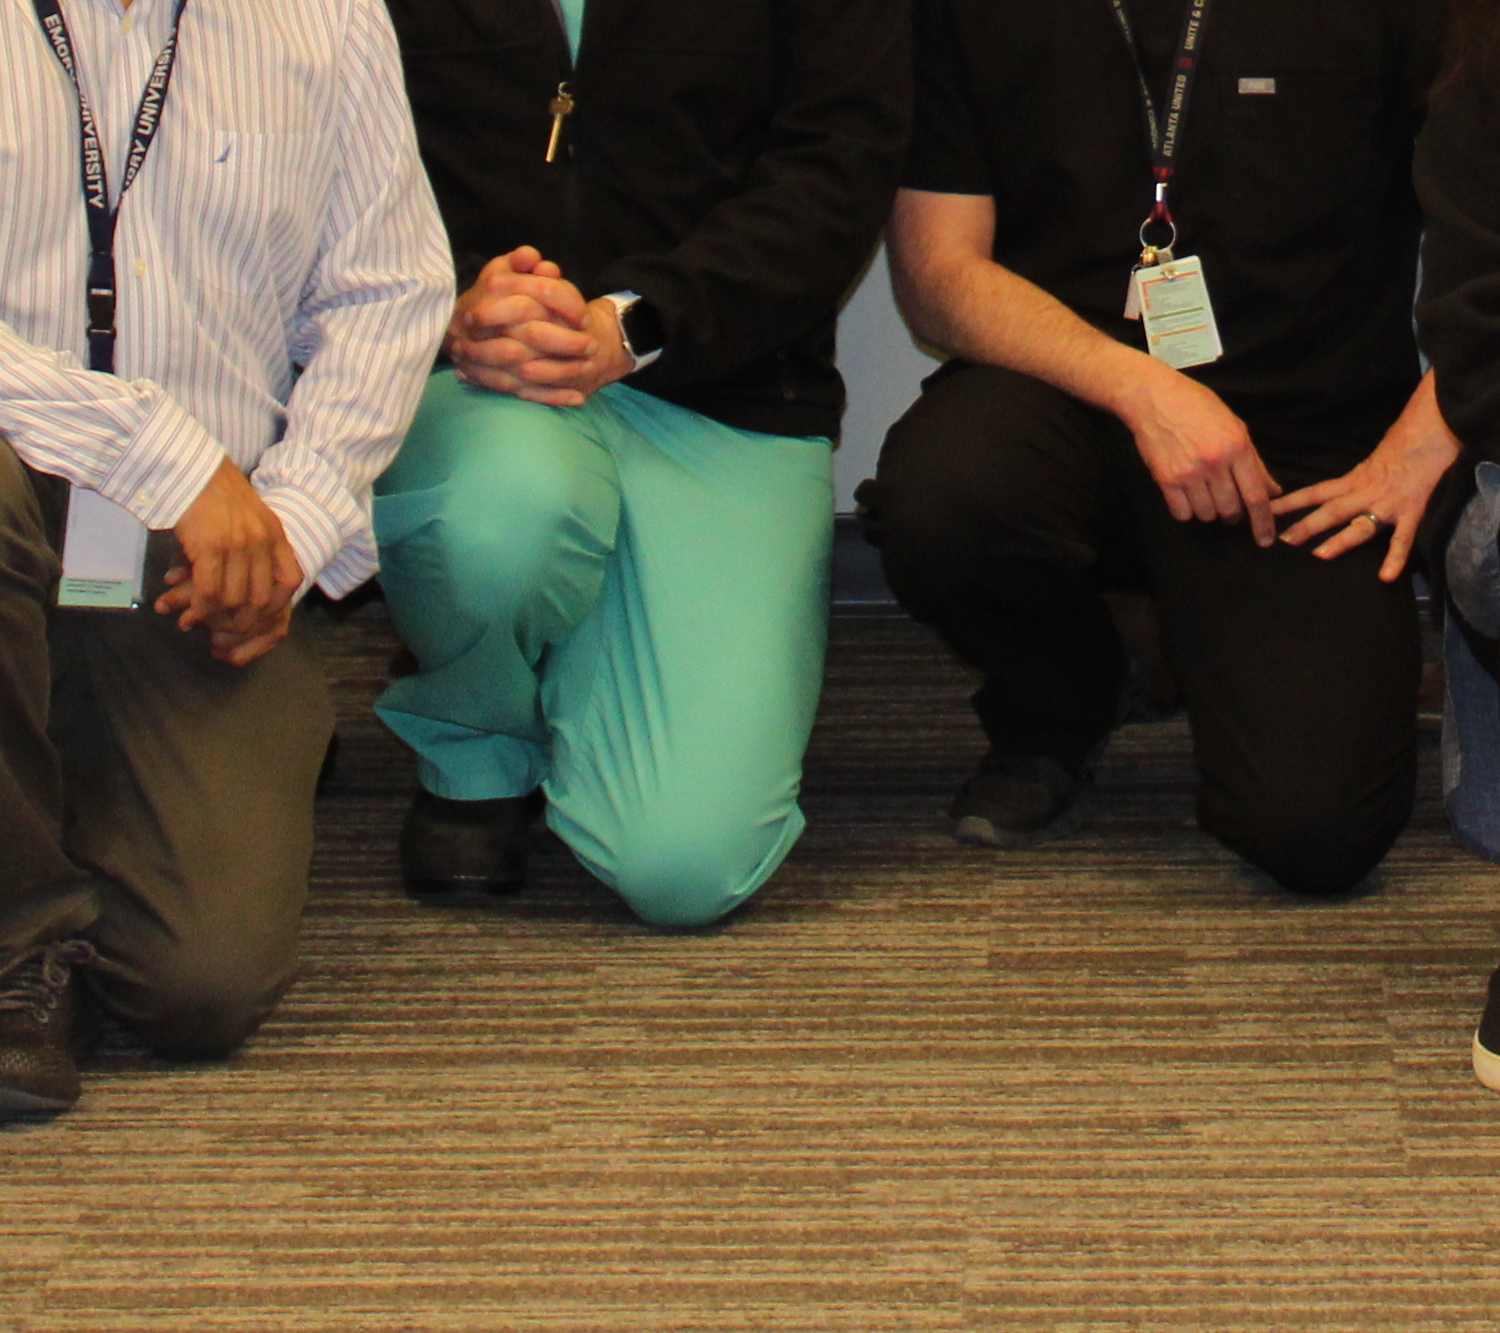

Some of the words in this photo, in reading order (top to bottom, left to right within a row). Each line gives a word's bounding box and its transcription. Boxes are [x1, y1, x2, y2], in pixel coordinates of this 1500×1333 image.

[1191, 9, 1202, 18] &
[1184, 20, 1200, 50] UNITE
[1162, 112, 1179, 157] ATLANTA
[1171, 74, 1187, 110] UNITED
[125, 139, 146, 186] ORY
